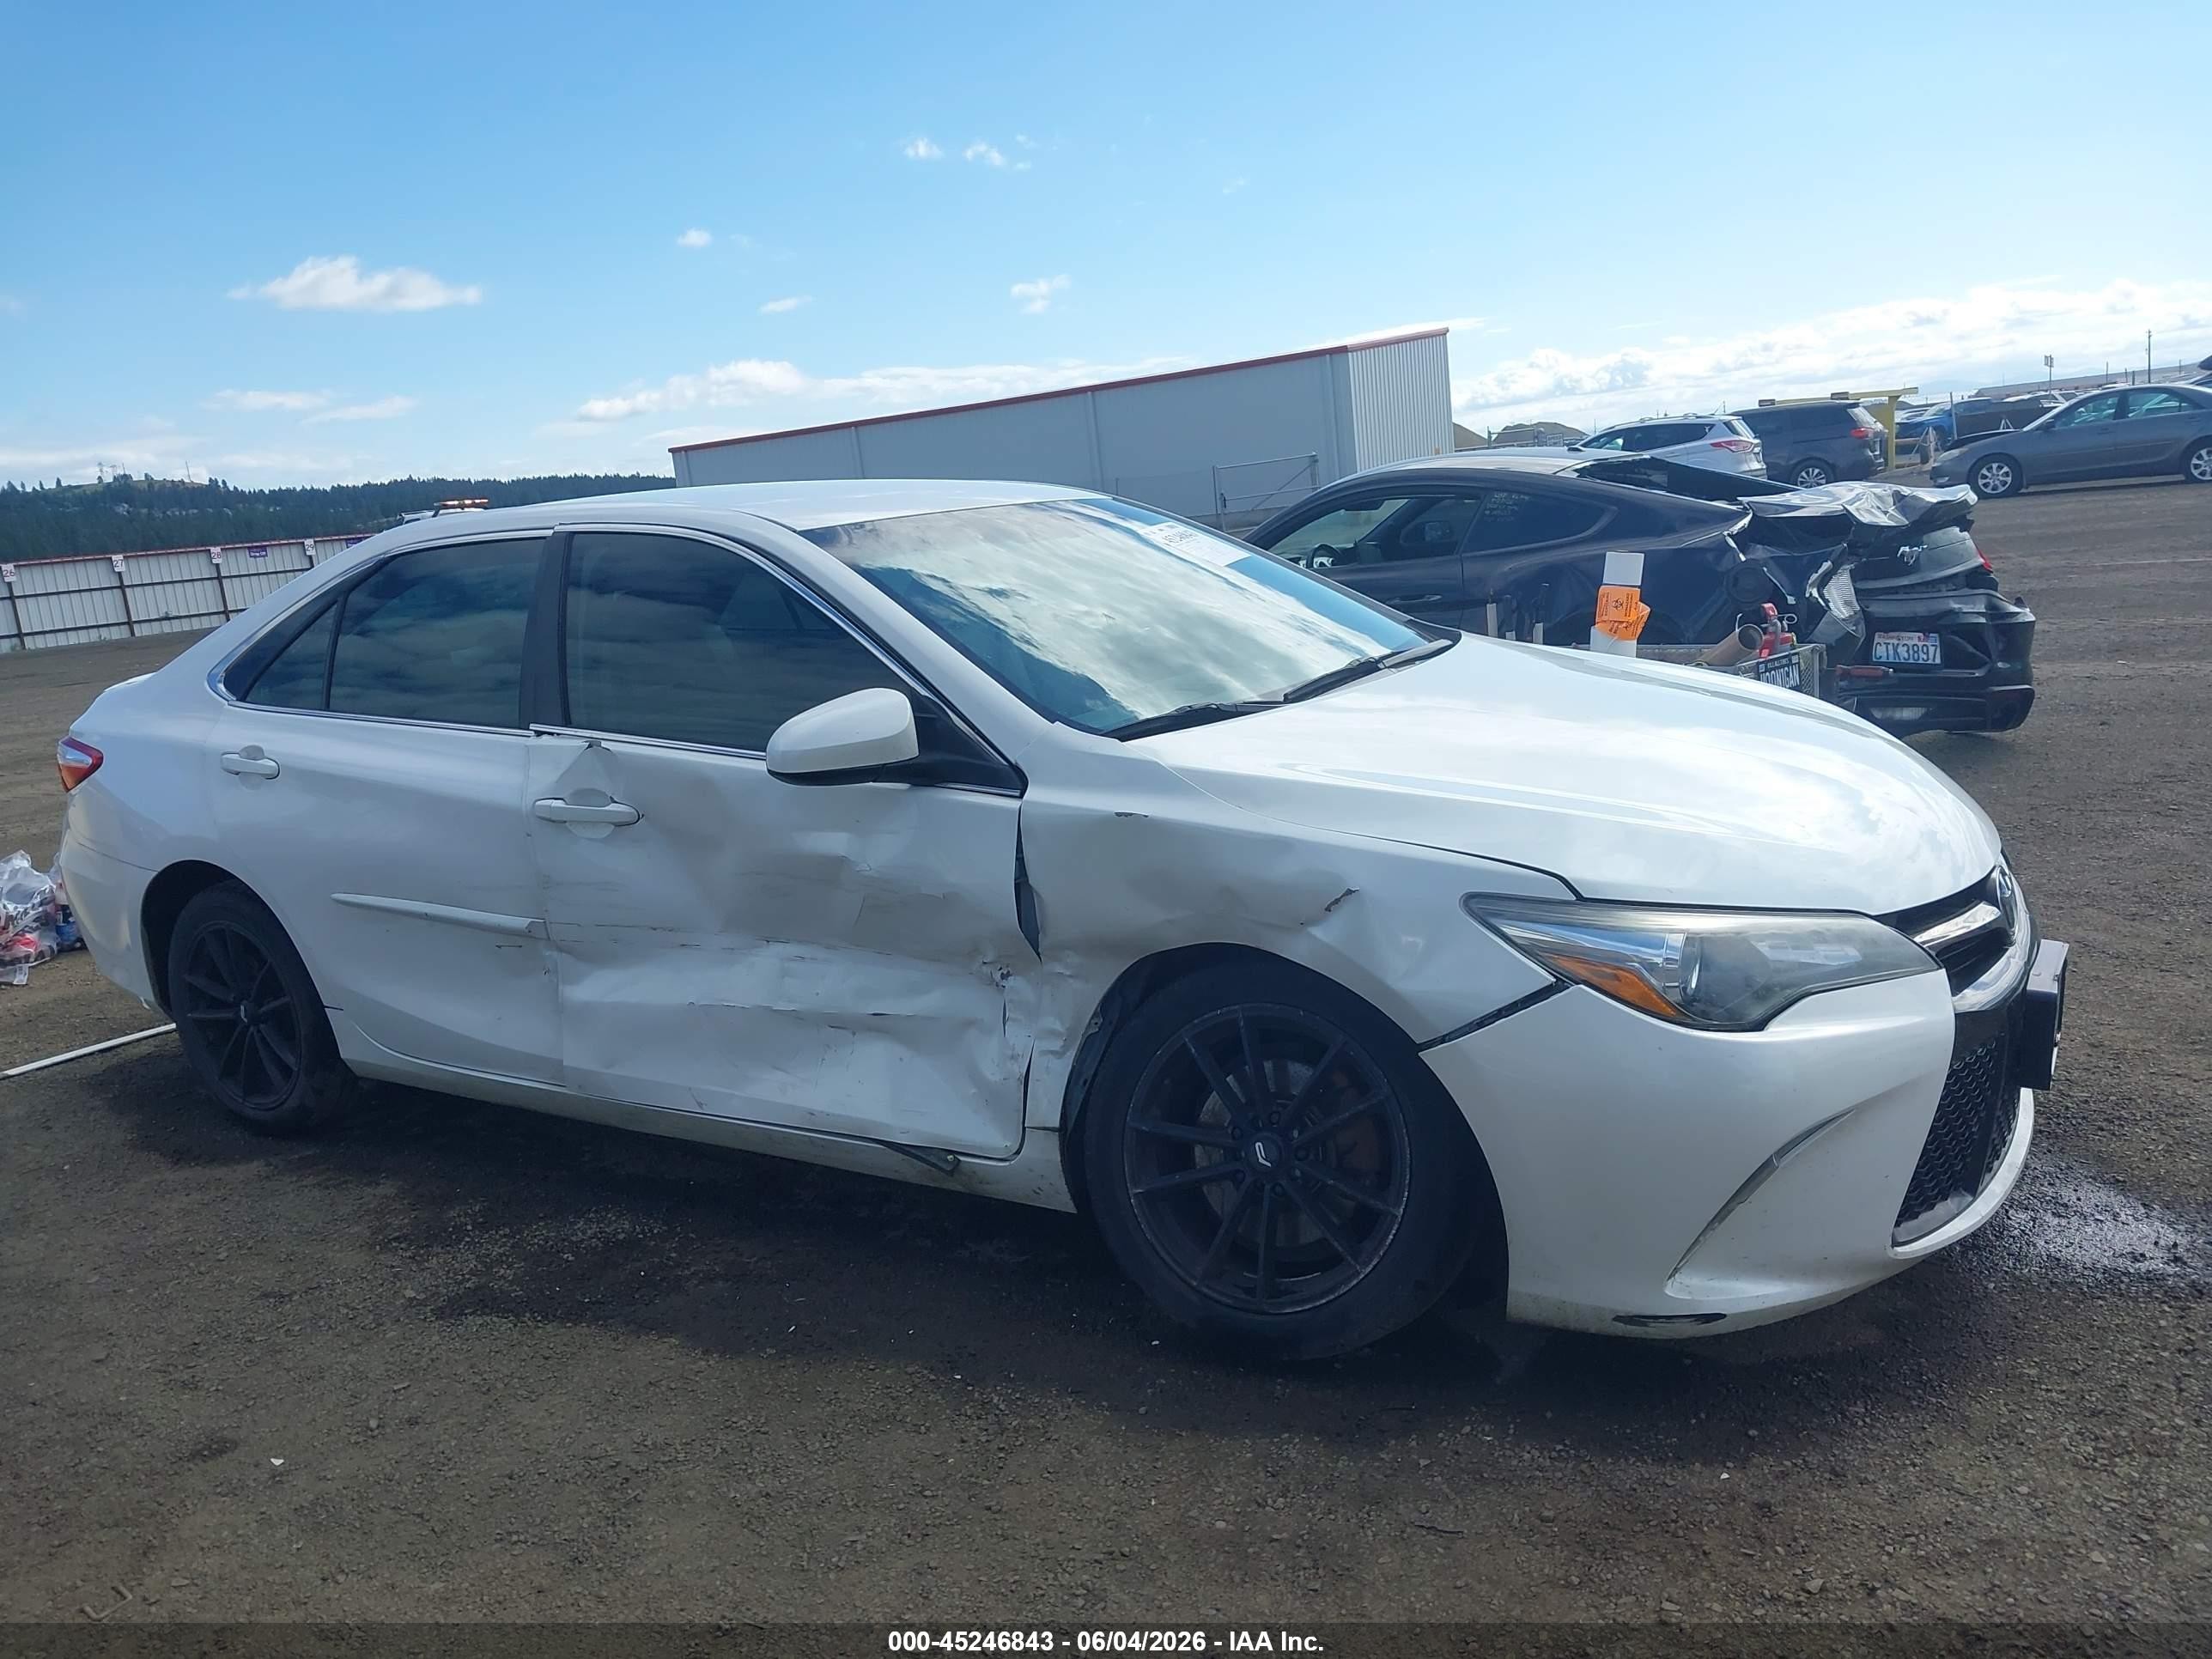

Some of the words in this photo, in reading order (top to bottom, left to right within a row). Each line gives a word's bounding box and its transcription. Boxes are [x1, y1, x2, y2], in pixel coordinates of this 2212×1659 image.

[113, 559, 124, 568] 27
[3, 568, 15, 577] 26
[1875, 642, 1938, 662] CTK3897
